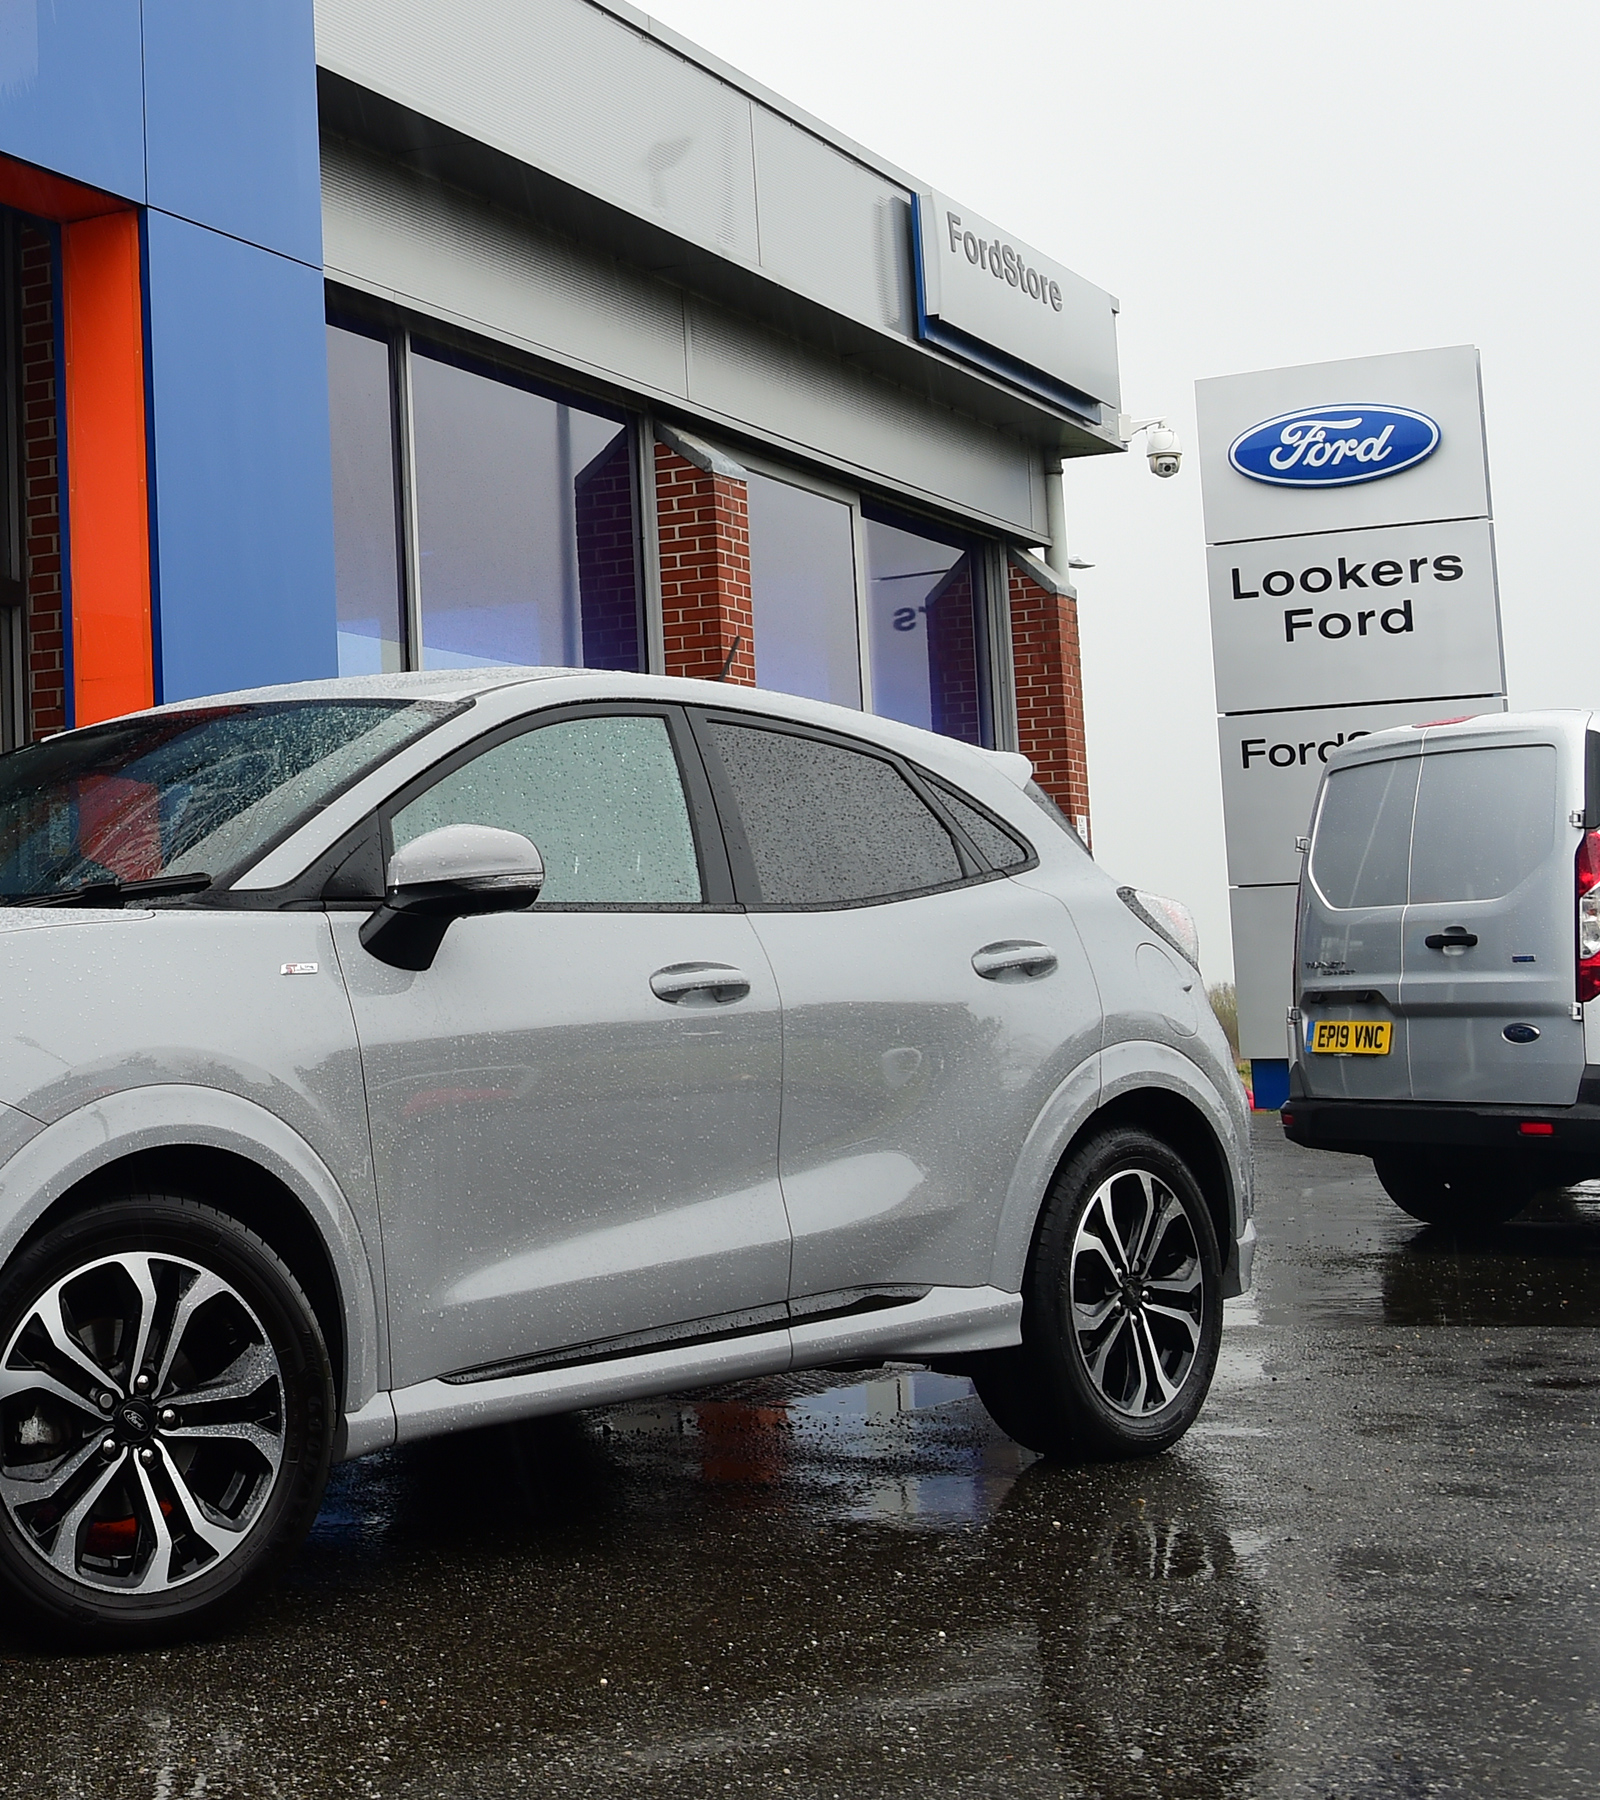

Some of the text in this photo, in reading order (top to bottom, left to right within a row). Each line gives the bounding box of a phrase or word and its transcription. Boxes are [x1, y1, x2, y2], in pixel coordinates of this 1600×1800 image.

[946, 211, 1063, 312] FordStore
[1269, 416, 1395, 471] Ford
[1231, 553, 1465, 600] Lookers
[1284, 599, 1415, 643] Ford
[1317, 1024, 1384, 1049] EP19 VNC
